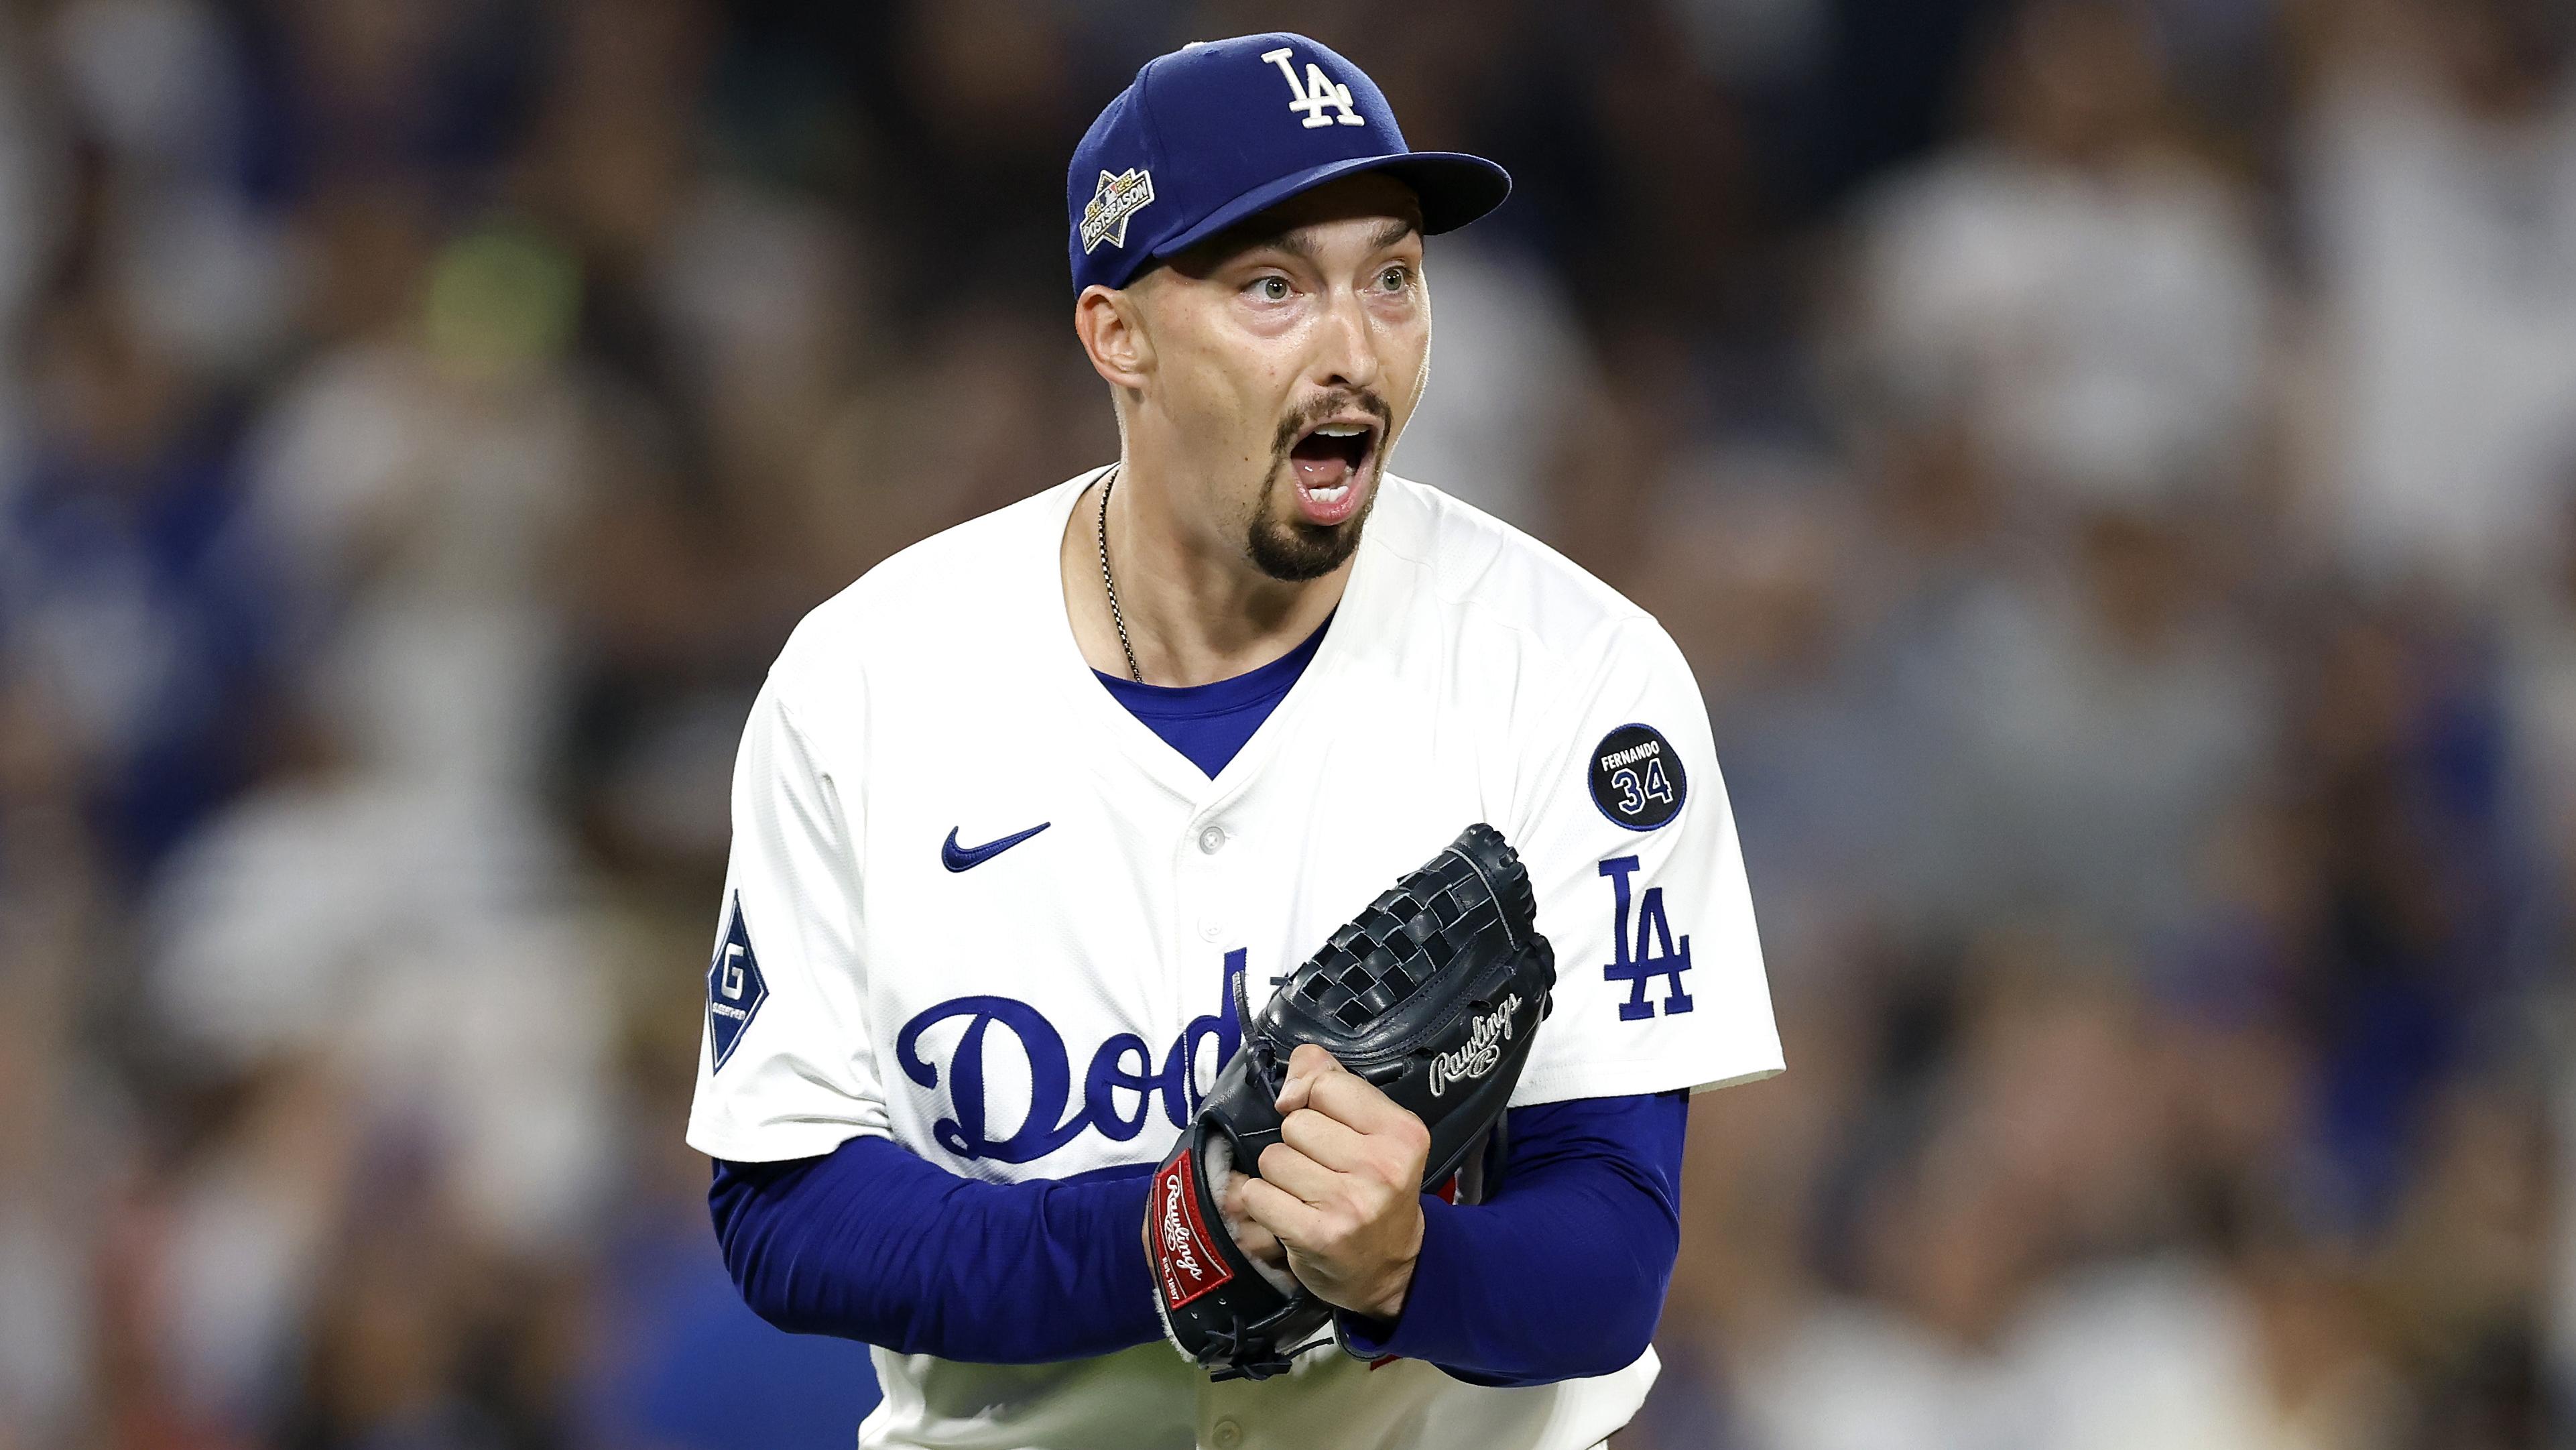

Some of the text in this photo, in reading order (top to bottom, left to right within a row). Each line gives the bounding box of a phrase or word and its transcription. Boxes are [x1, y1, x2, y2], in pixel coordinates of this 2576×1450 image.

[1261, 48, 1365, 129] LA
[1082, 180, 1148, 244] POSTSEASON
[1601, 740, 1660, 772] FERNANDO
[1611, 758, 1673, 814] 34
[721, 942, 745, 1000] G
[1598, 855, 1694, 1021] LA
[1429, 993, 1523, 1097] Rawlings
[1164, 1174, 1203, 1281] Rawlings
